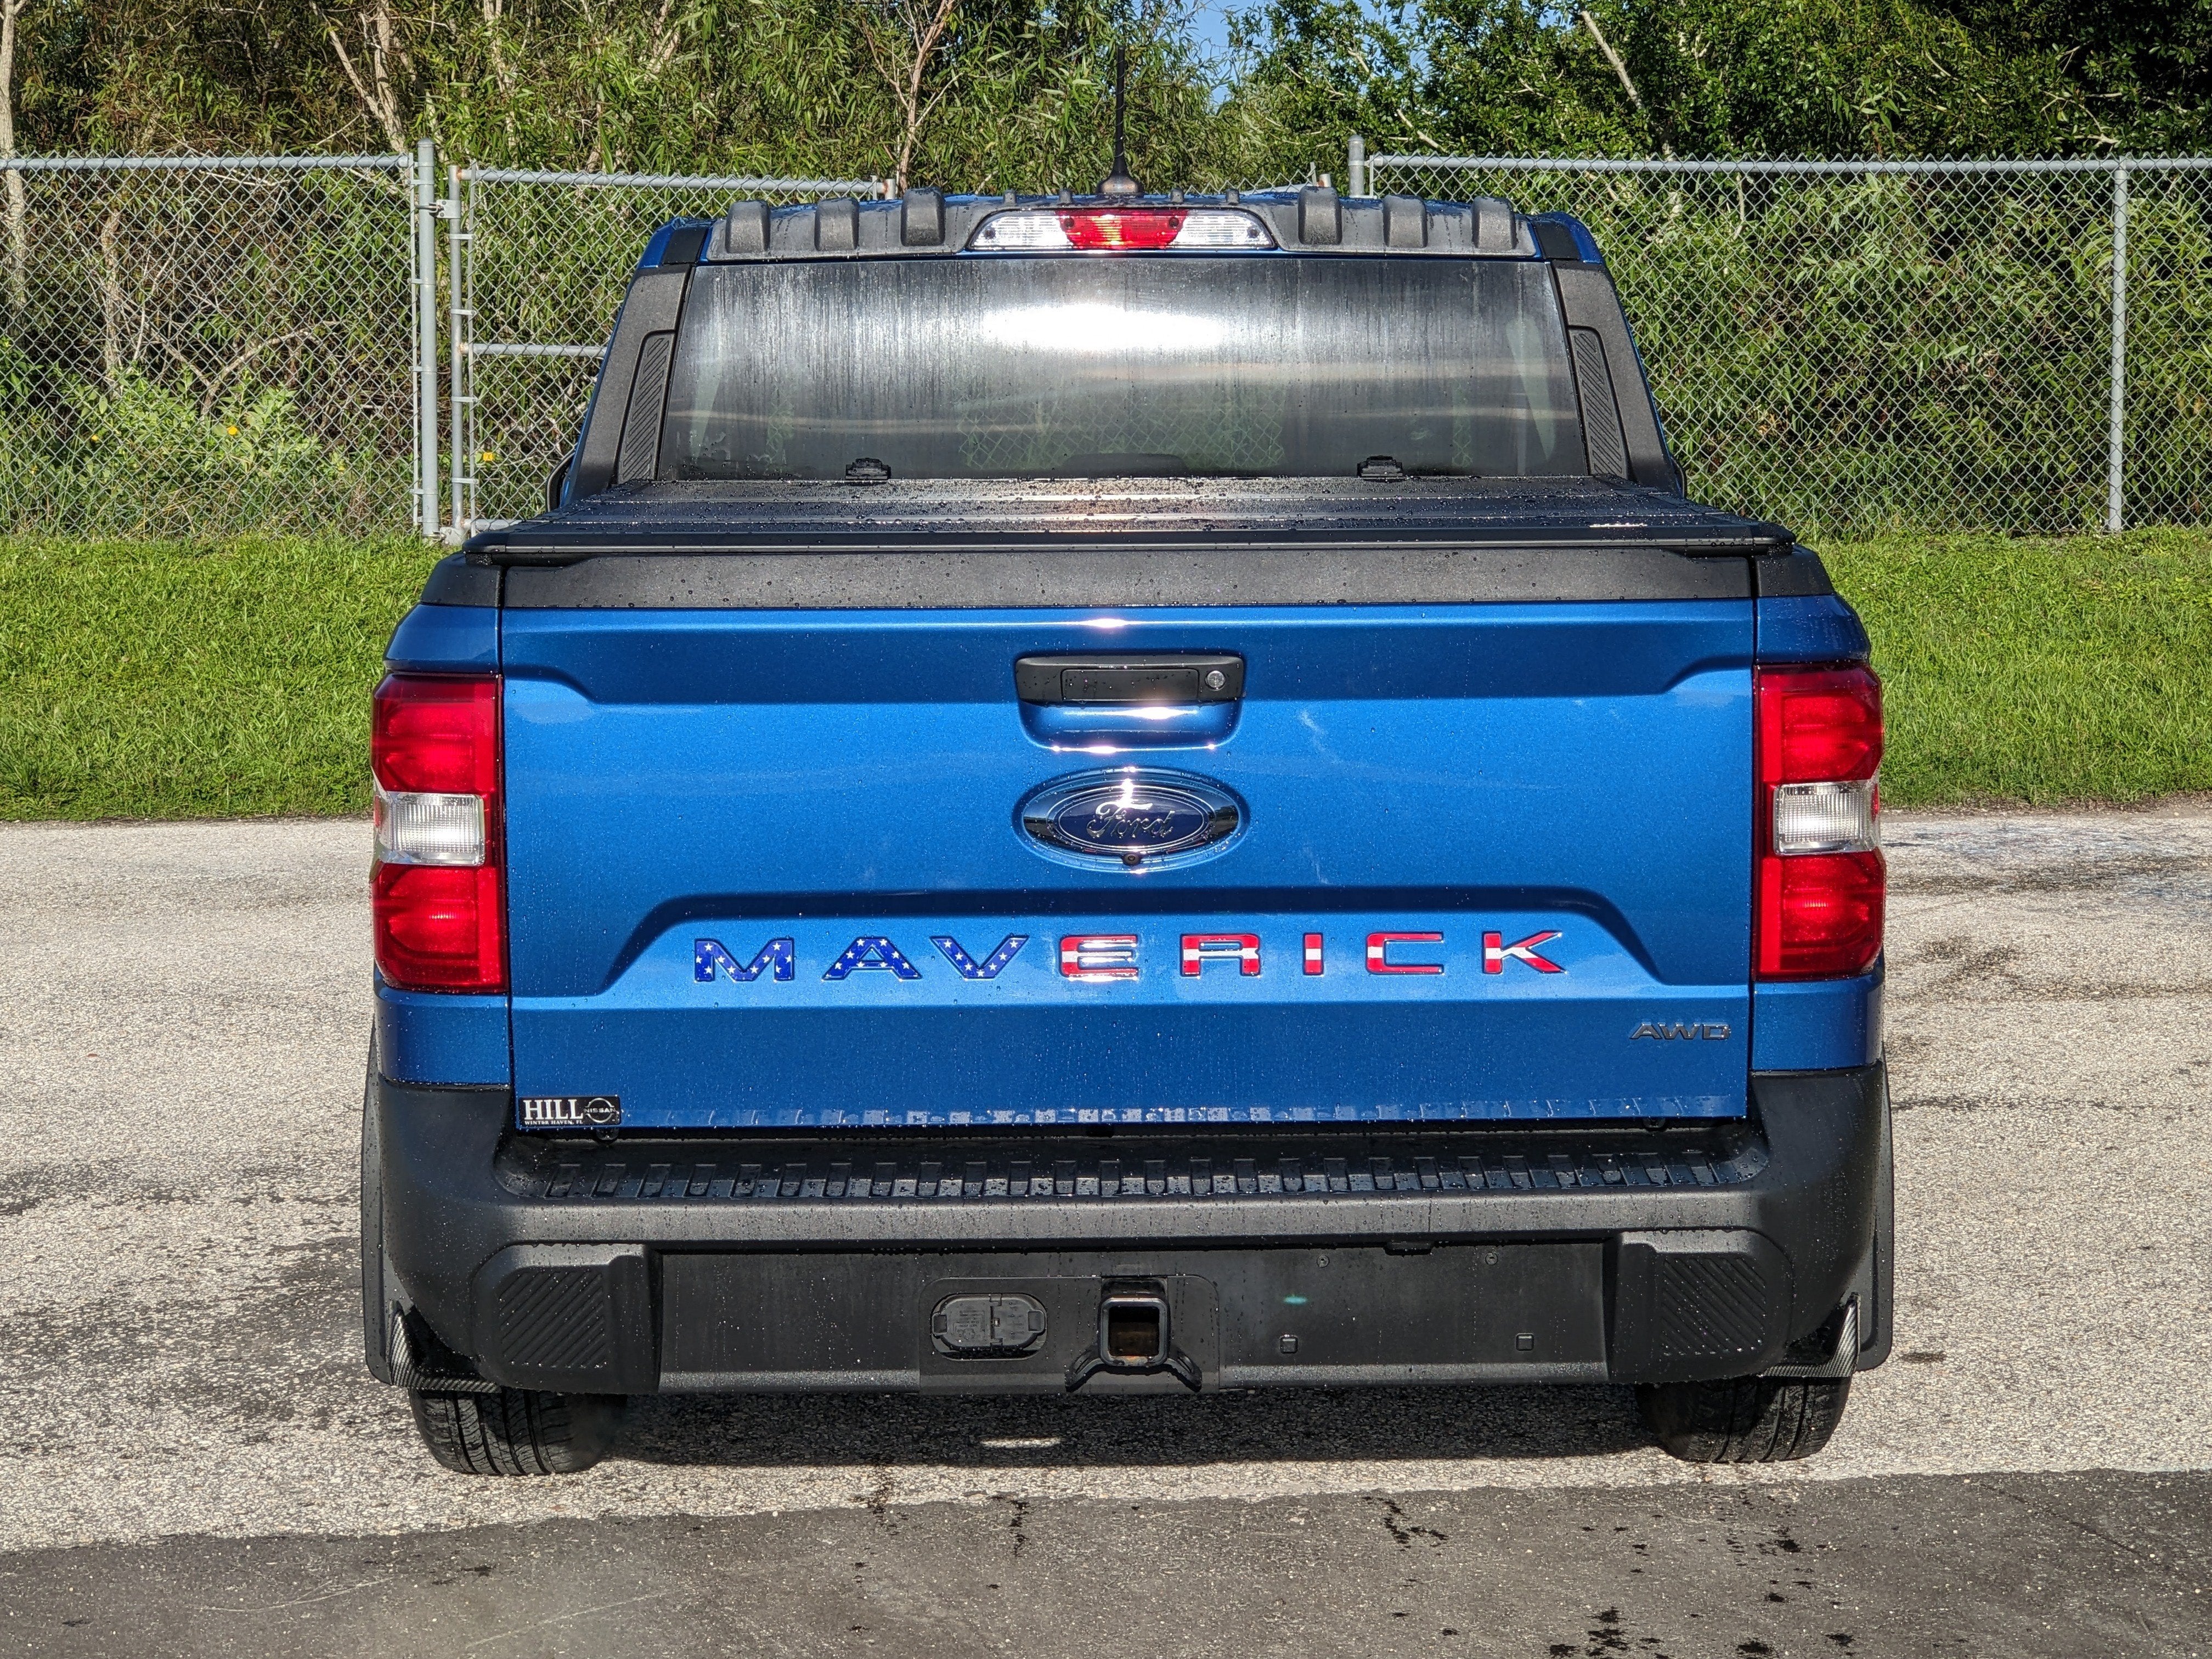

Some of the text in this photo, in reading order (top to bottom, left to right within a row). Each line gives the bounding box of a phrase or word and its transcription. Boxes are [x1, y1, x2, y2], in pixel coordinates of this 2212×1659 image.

[1086, 799, 1176, 837] Ford
[694, 930, 1567, 983] MAVERICK
[1629, 1022, 1731, 1040] AWD
[523, 1099, 583, 1120] HILL
